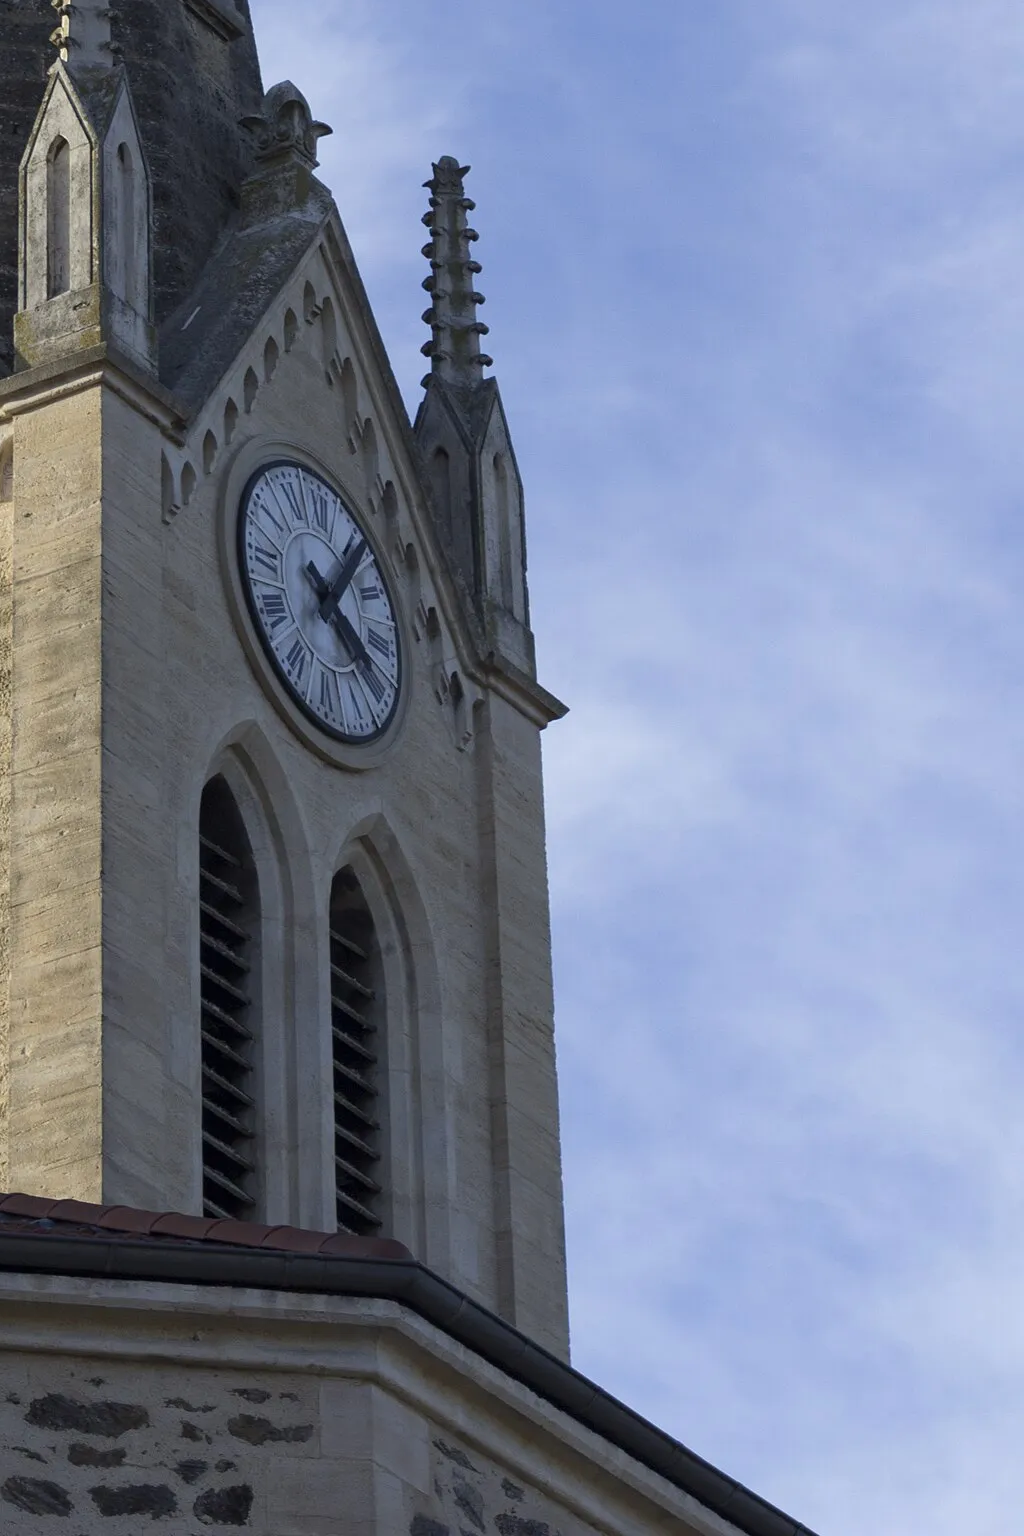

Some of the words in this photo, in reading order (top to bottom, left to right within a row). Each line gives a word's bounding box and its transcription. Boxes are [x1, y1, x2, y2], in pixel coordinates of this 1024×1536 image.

[260, 504, 284, 532] X
[280, 482, 304, 521] XI
[310, 488, 328, 533] XII
[255, 545, 278, 575] IX
[360, 586, 380, 600] II
[262, 594, 288, 629] VIII
[286, 640, 306, 680] VII
[367, 627, 389, 659] III
[320, 670, 334, 713] VI
